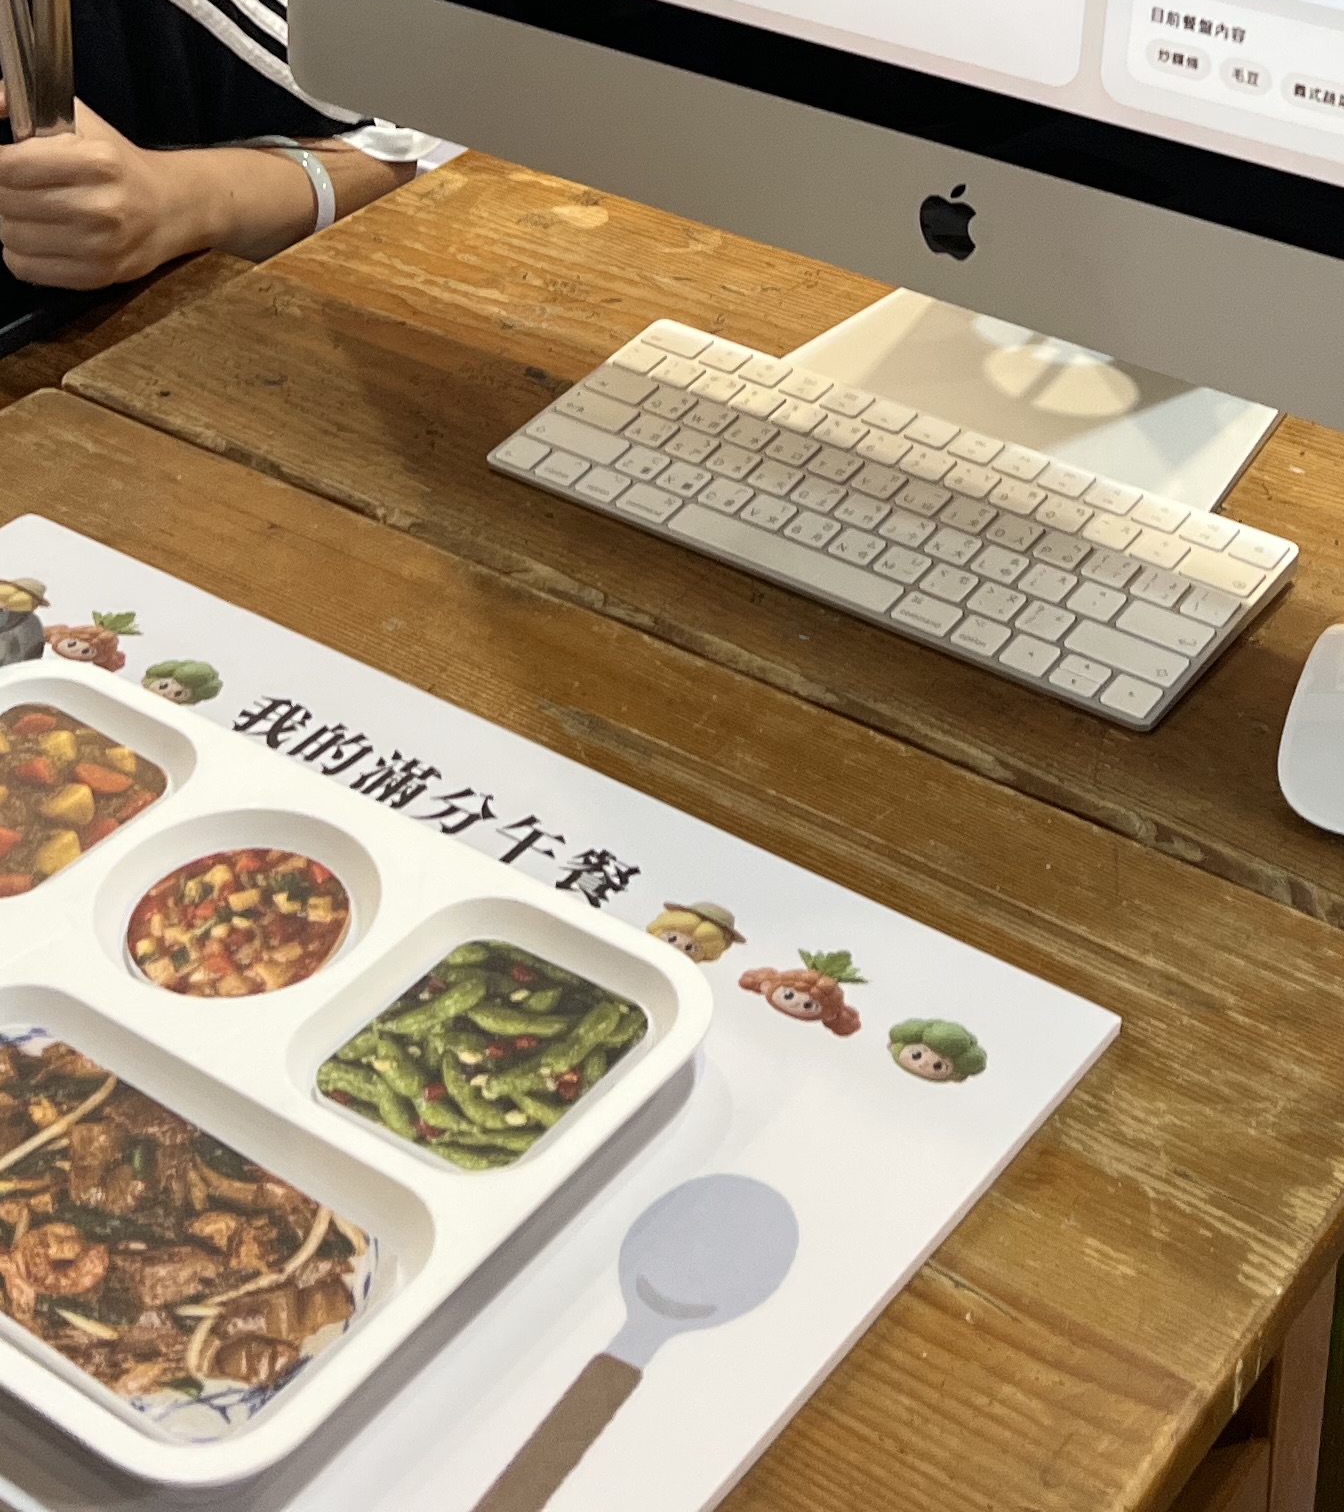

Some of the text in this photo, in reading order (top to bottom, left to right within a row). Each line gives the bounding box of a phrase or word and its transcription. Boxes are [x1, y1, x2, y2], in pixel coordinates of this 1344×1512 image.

[1150, 6, 1247, 44] 目前餐盤內容
[1232, 68, 1260, 87] 毛豆
[231, 694, 642, 909] 我的滿分午餐
